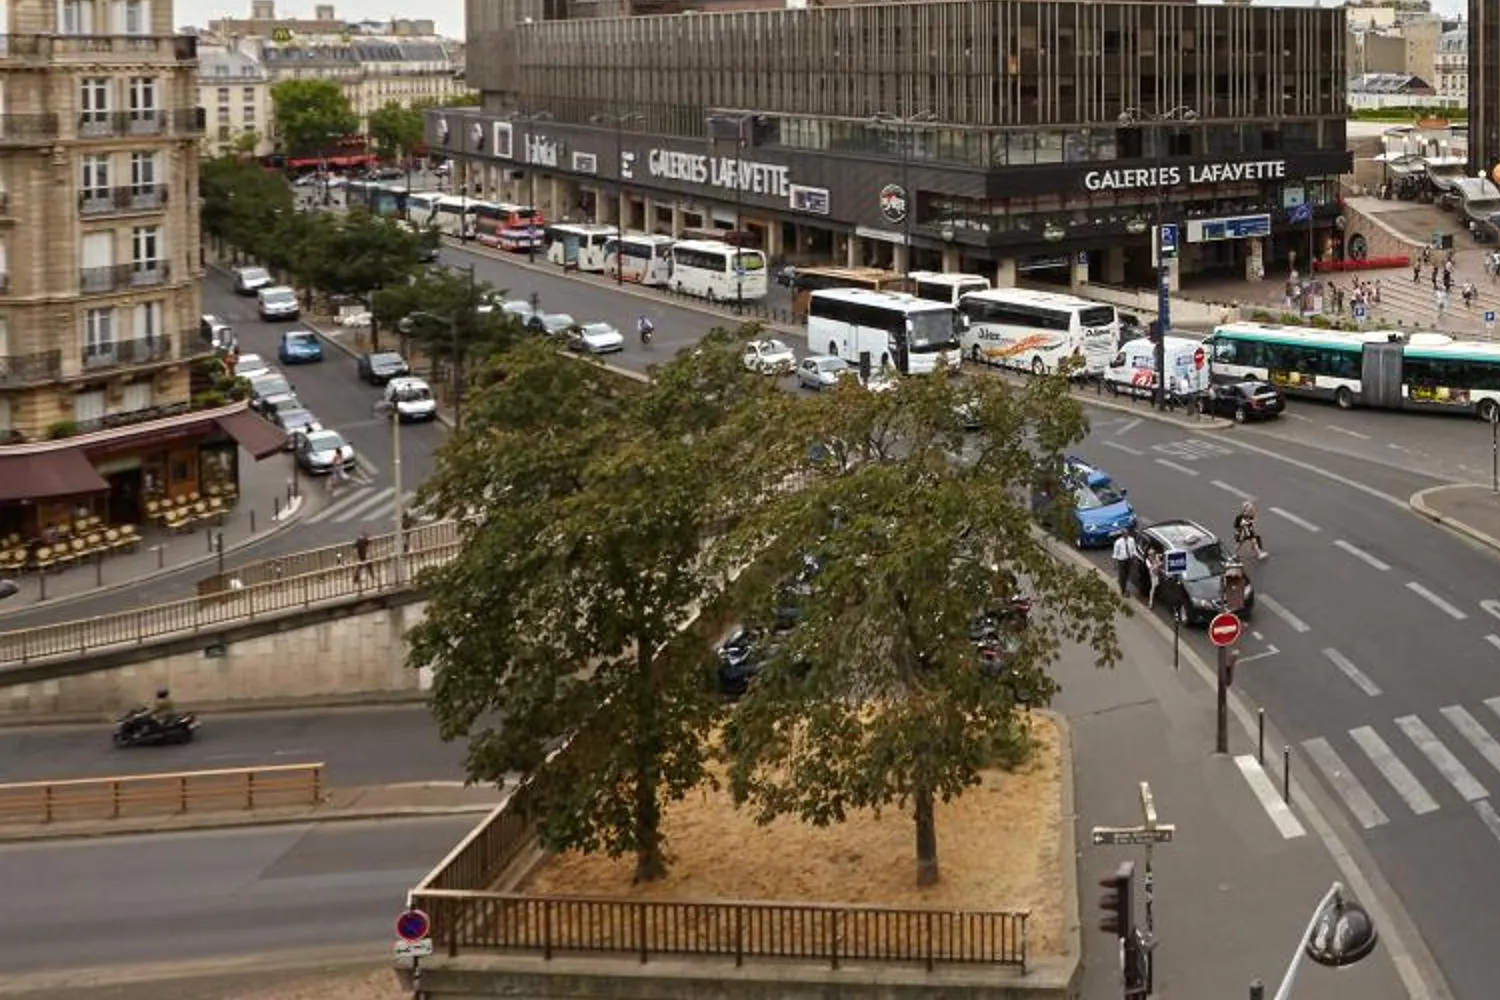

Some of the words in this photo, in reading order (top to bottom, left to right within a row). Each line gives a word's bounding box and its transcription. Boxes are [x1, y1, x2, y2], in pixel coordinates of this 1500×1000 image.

[649, 149, 707, 184] GALERIES
[709, 157, 790, 197] LAFAYETTE
[1085, 166, 1181, 191] GALERIES
[1189, 160, 1286, 183] LAFAYETTE
